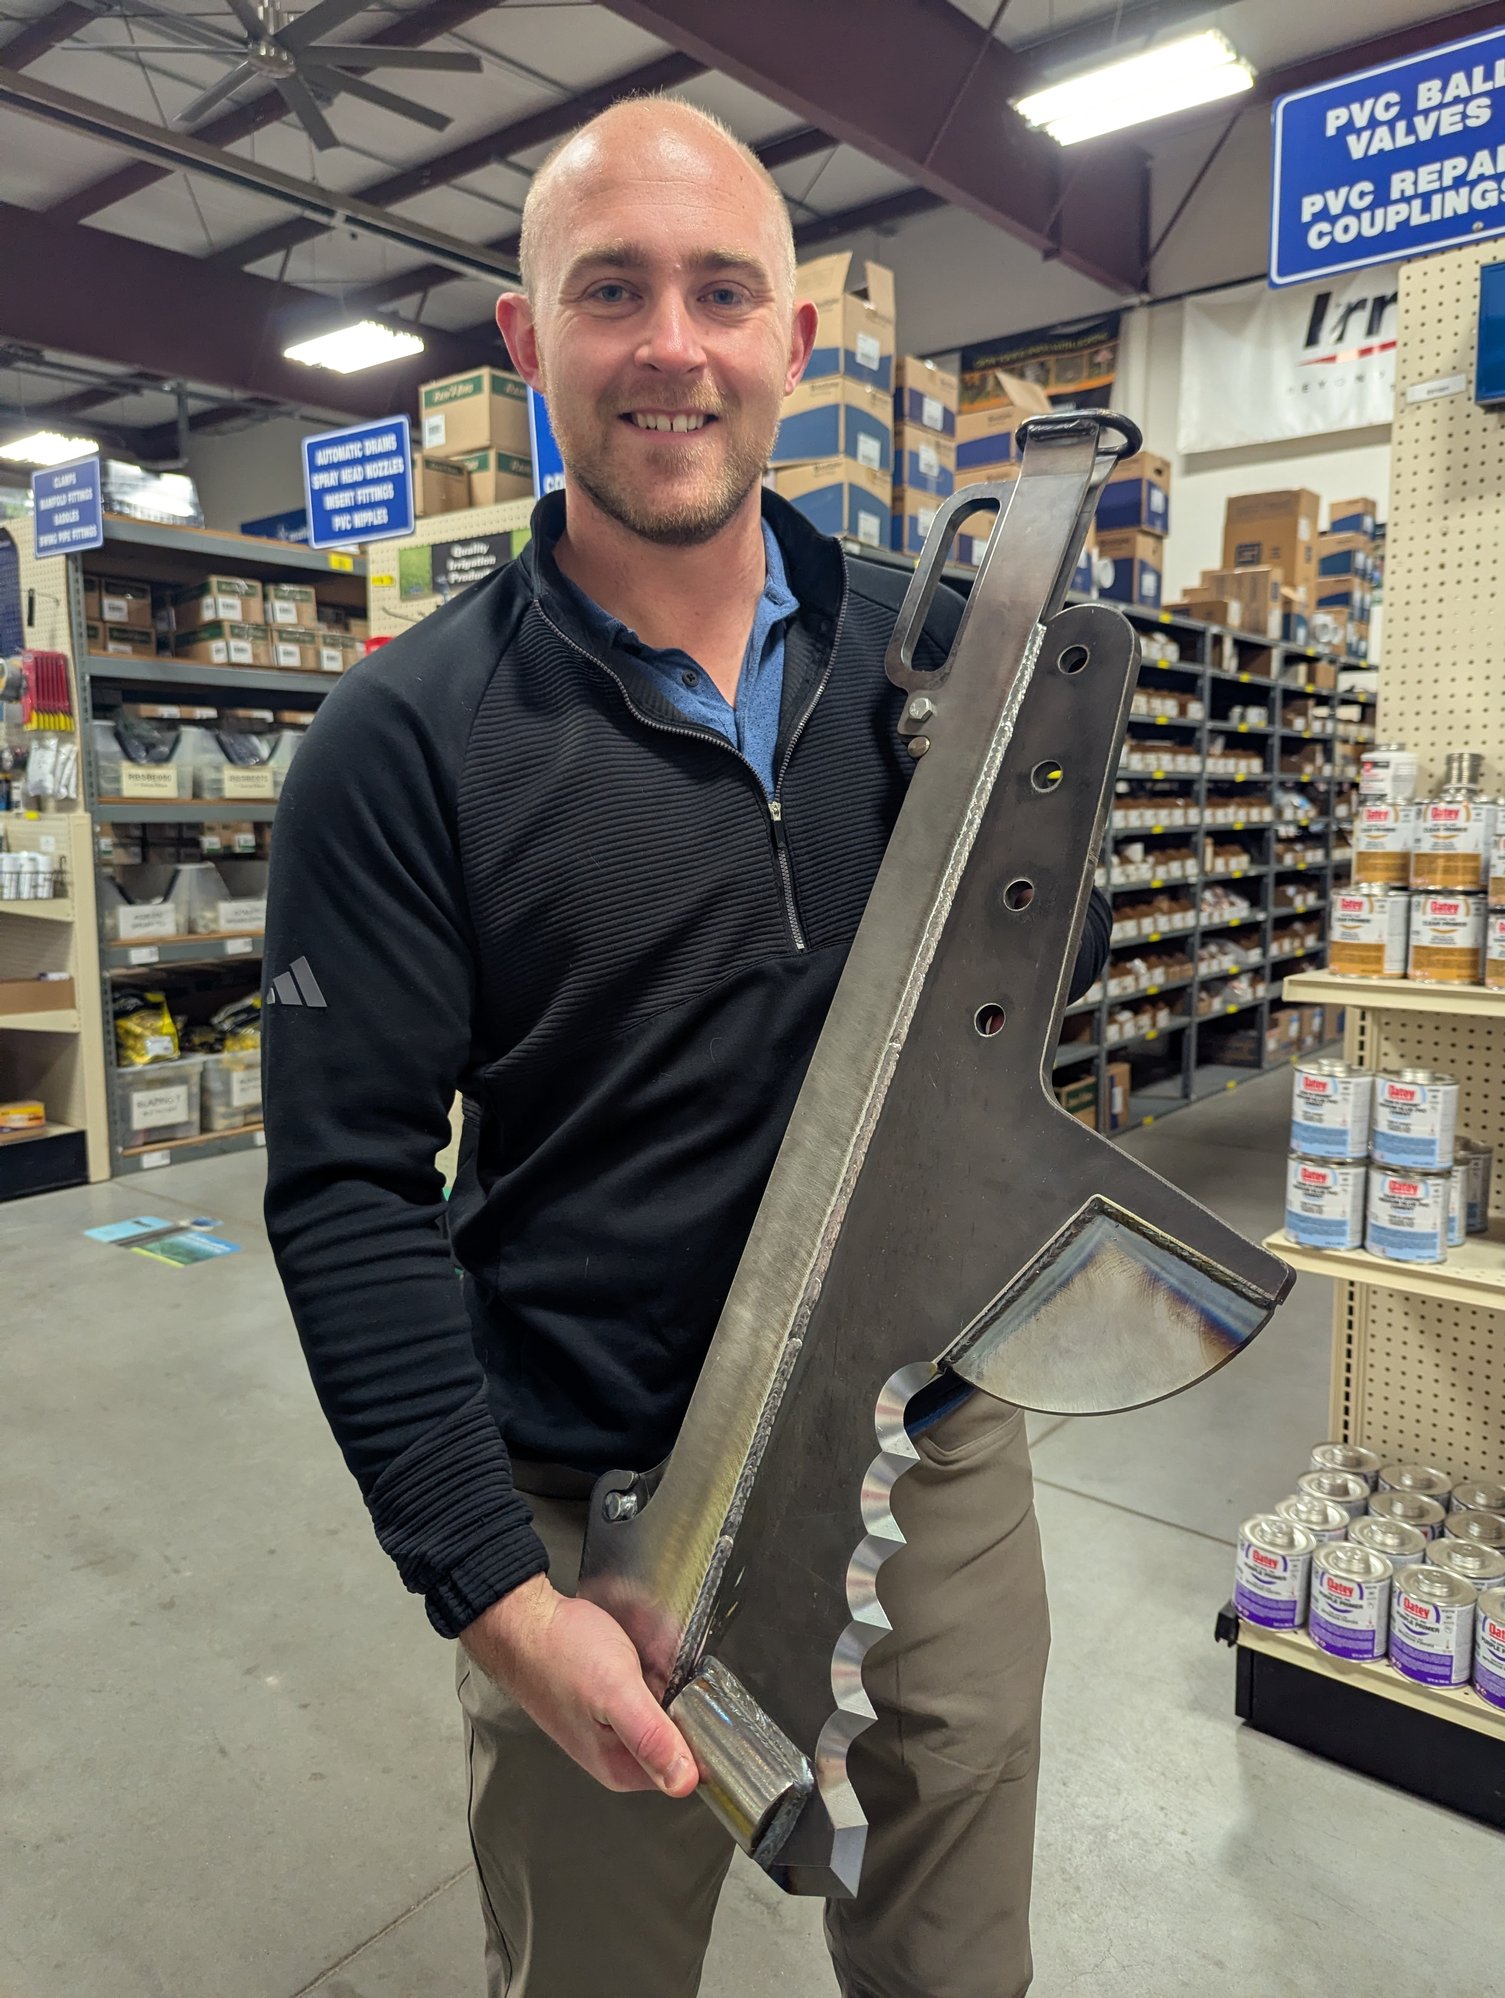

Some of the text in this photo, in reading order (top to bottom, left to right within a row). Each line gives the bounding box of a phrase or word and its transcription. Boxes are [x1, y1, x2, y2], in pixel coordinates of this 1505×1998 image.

[1326, 92, 1400, 137] PVC
[1346, 97, 1492, 160] VALVES
[1301, 180, 1374, 223] PVC
[1306, 178, 1505, 250] COUPLING
[315, 433, 397, 466] AUTOMATIC DRAINS
[311, 456, 404, 490] SPRAY HEAD NOZZLES
[323, 481, 394, 511] INSERT FITTINGS
[331, 512, 352, 532] PVC
[352, 506, 388, 528] NIPPLES
[446, 554, 497, 572] Irrigation
[450, 542, 490, 558] Quality
[1430, 900, 1459, 916] Oatey
[1252, 1549, 1278, 1569] Oatey
[1327, 1576, 1354, 1598] Oatey
[1403, 1596, 1430, 1620] Oatey
